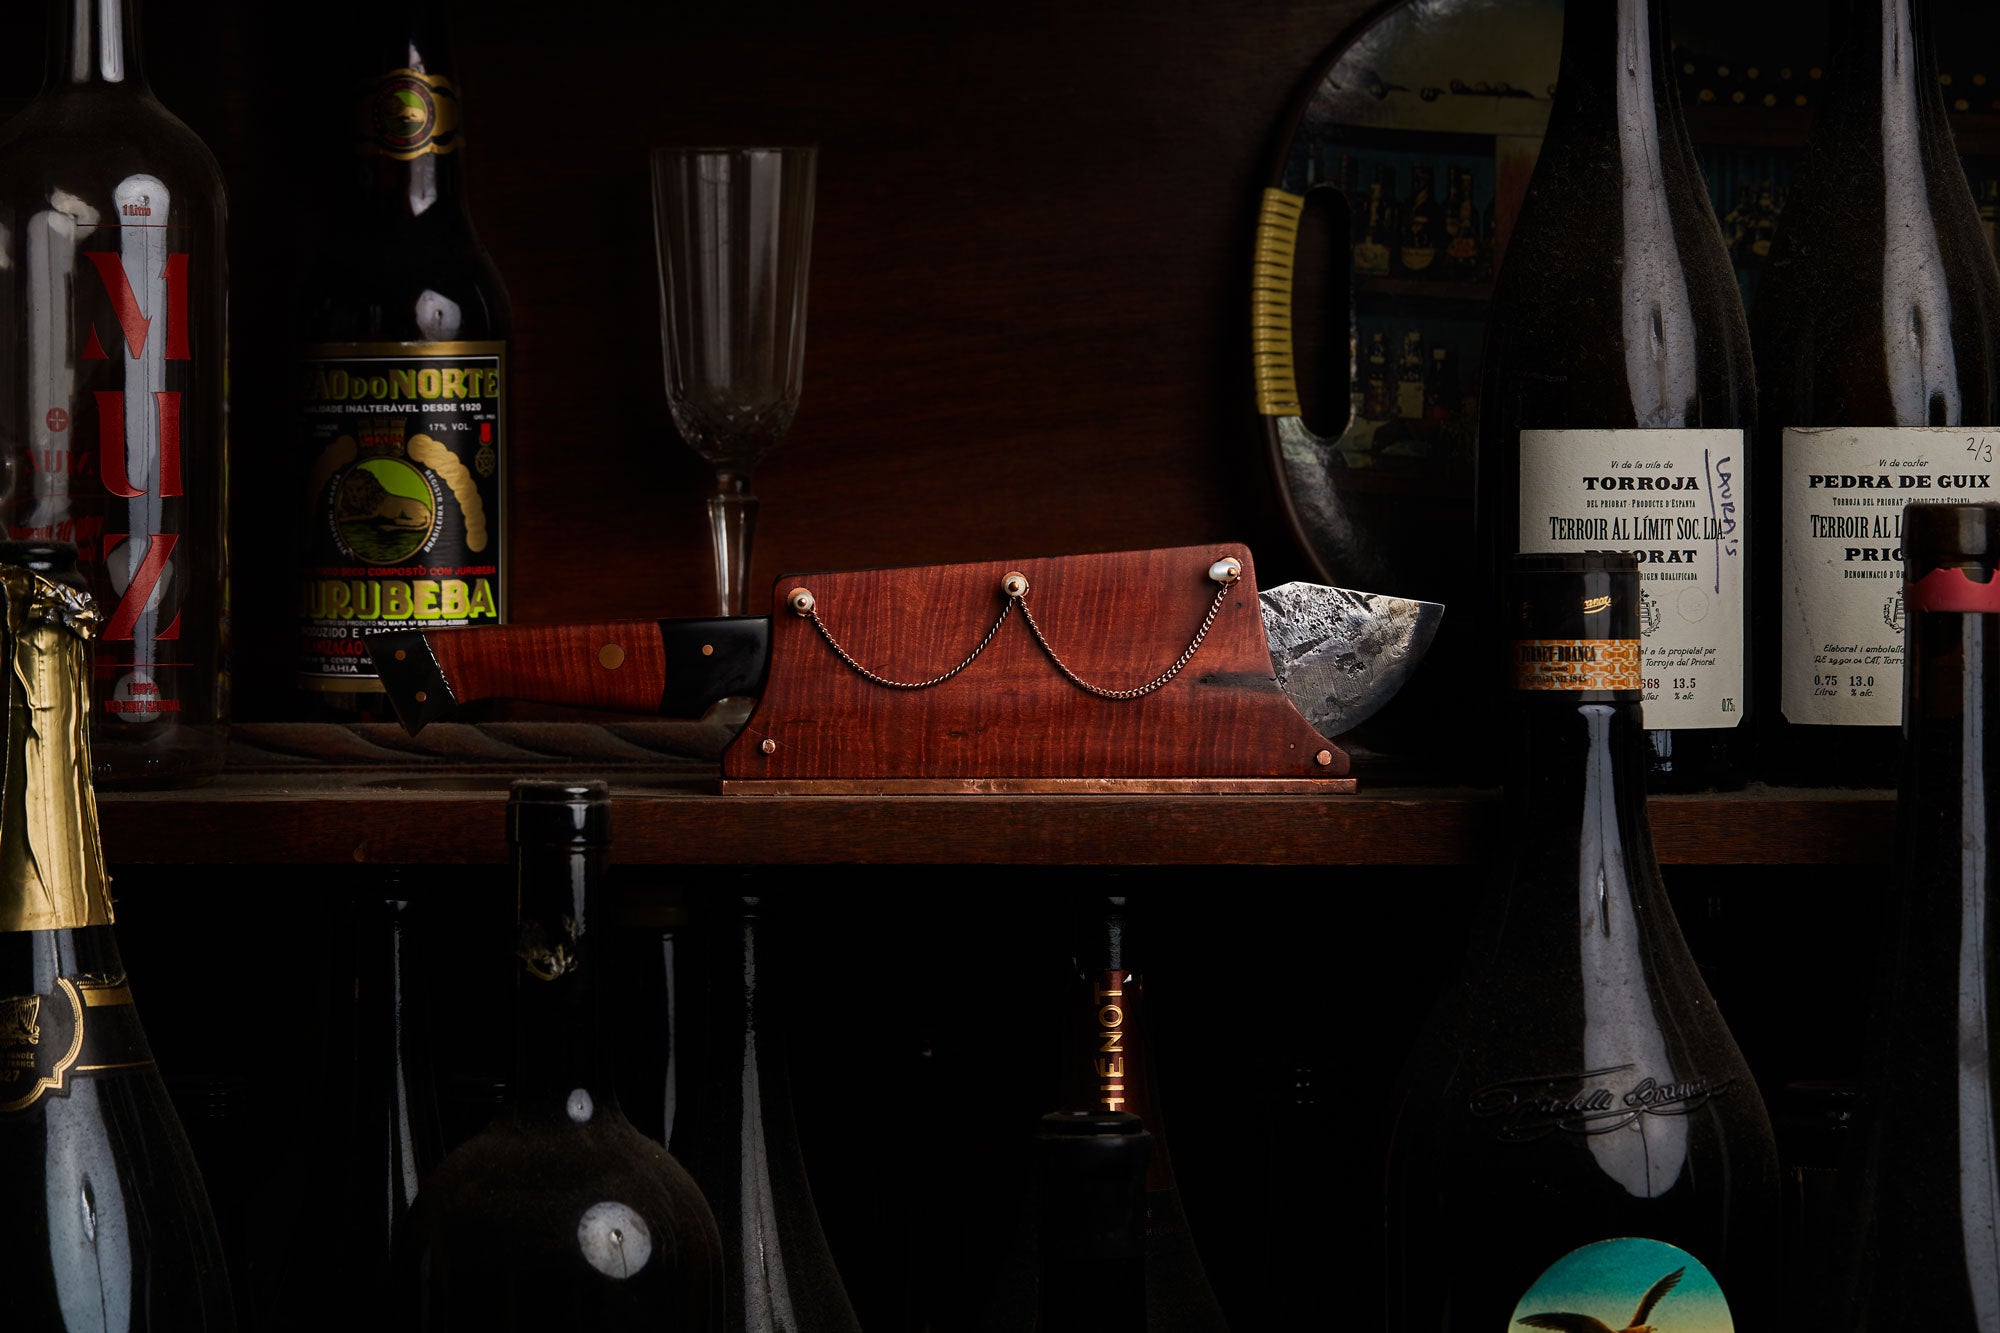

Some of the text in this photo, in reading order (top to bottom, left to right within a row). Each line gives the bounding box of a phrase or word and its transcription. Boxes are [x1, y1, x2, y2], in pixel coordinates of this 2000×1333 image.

[388, 367, 499, 400] NORTE
[345, 402, 419, 413] INALTERÁVEL
[422, 404, 457, 412] DESDE
[460, 403, 482, 412] 1920
[428, 423, 448, 432] 17%
[1966, 437, 1993, 463] 2/3
[1611, 460, 1619, 469] Vi
[1621, 460, 1632, 469] de
[1634, 460, 1643, 469] la
[1663, 460, 1674, 469] de
[1879, 459, 1929, 468] Vi de coster
[1583, 476, 1699, 491] TORROJA
[1809, 474, 1990, 488] PEDRA DE GUIX
[1550, 516, 1608, 540] TERROIR
[1612, 517, 1630, 540] AL
[1634, 515, 1674, 540] LÍMIT
[1677, 516, 1701, 540] SOC.
[1811, 514, 1869, 538] TERROIR
[1873, 516, 1891, 538] AL
[1584, 550, 1697, 564] ORAT
[367, 566, 427, 577] COMPOSTO
[1639, 572, 1658, 581] RIGEN
[303, 578, 498, 620] URUBEBA
[352, 628, 360, 638] E
[1676, 658, 1690, 667] del
[322, 664, 358, 673] BAHIA
[1673, 678, 1696, 689] 13.5
[1814, 676, 1874, 687] 0.75 13.0
[1674, 692, 1680, 700] %
[1094, 984, 1125, 1112] HIENOT
